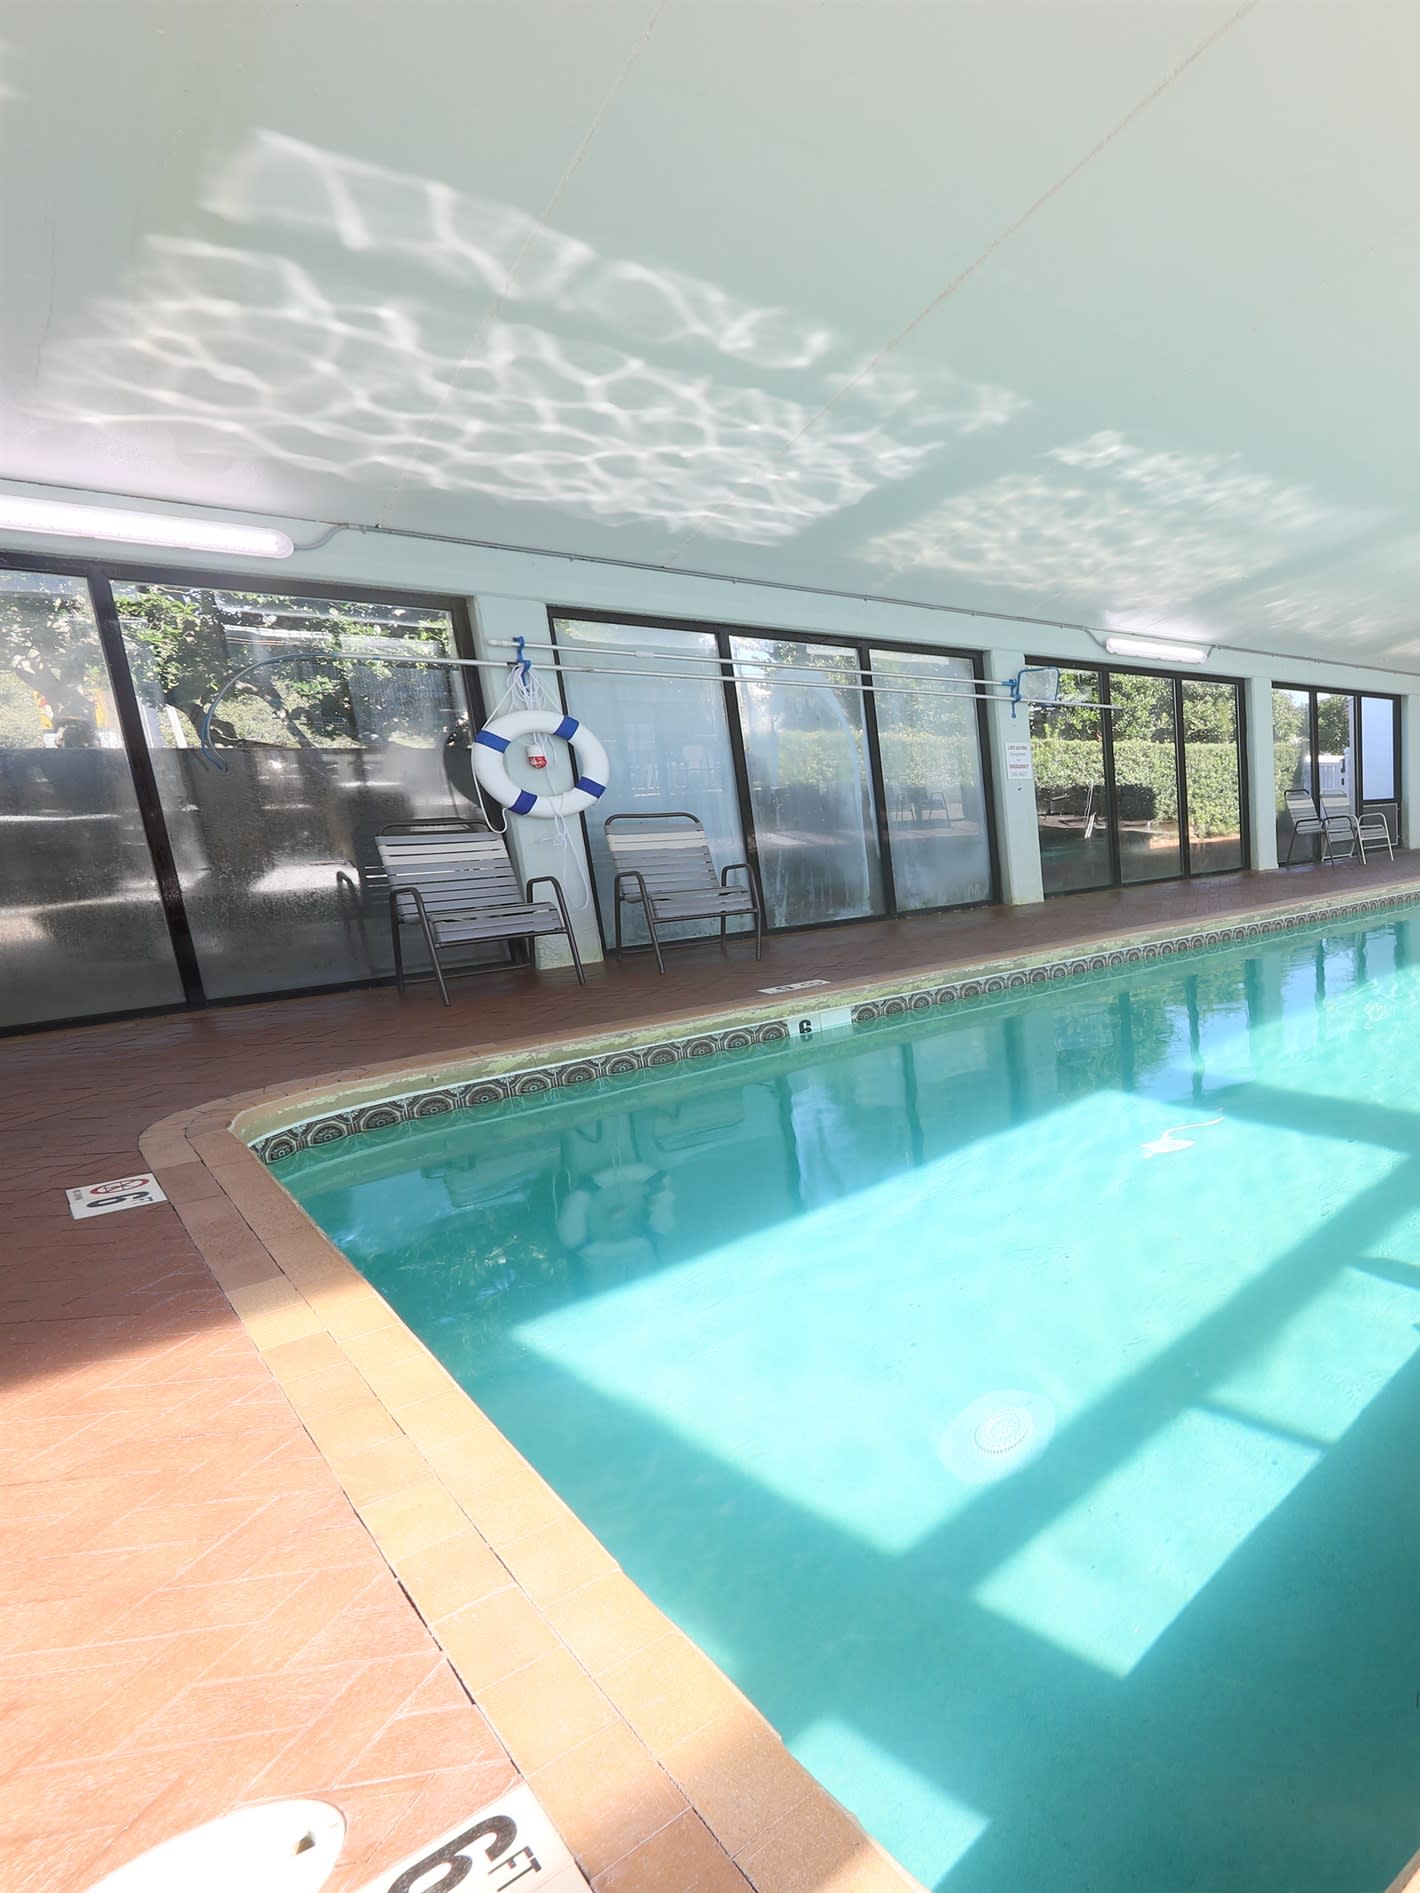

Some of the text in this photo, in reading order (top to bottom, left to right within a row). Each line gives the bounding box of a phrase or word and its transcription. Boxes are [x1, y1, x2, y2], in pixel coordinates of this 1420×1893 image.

[86, 1191, 150, 1208] 6
[387, 1815, 543, 1893] 6 FT
